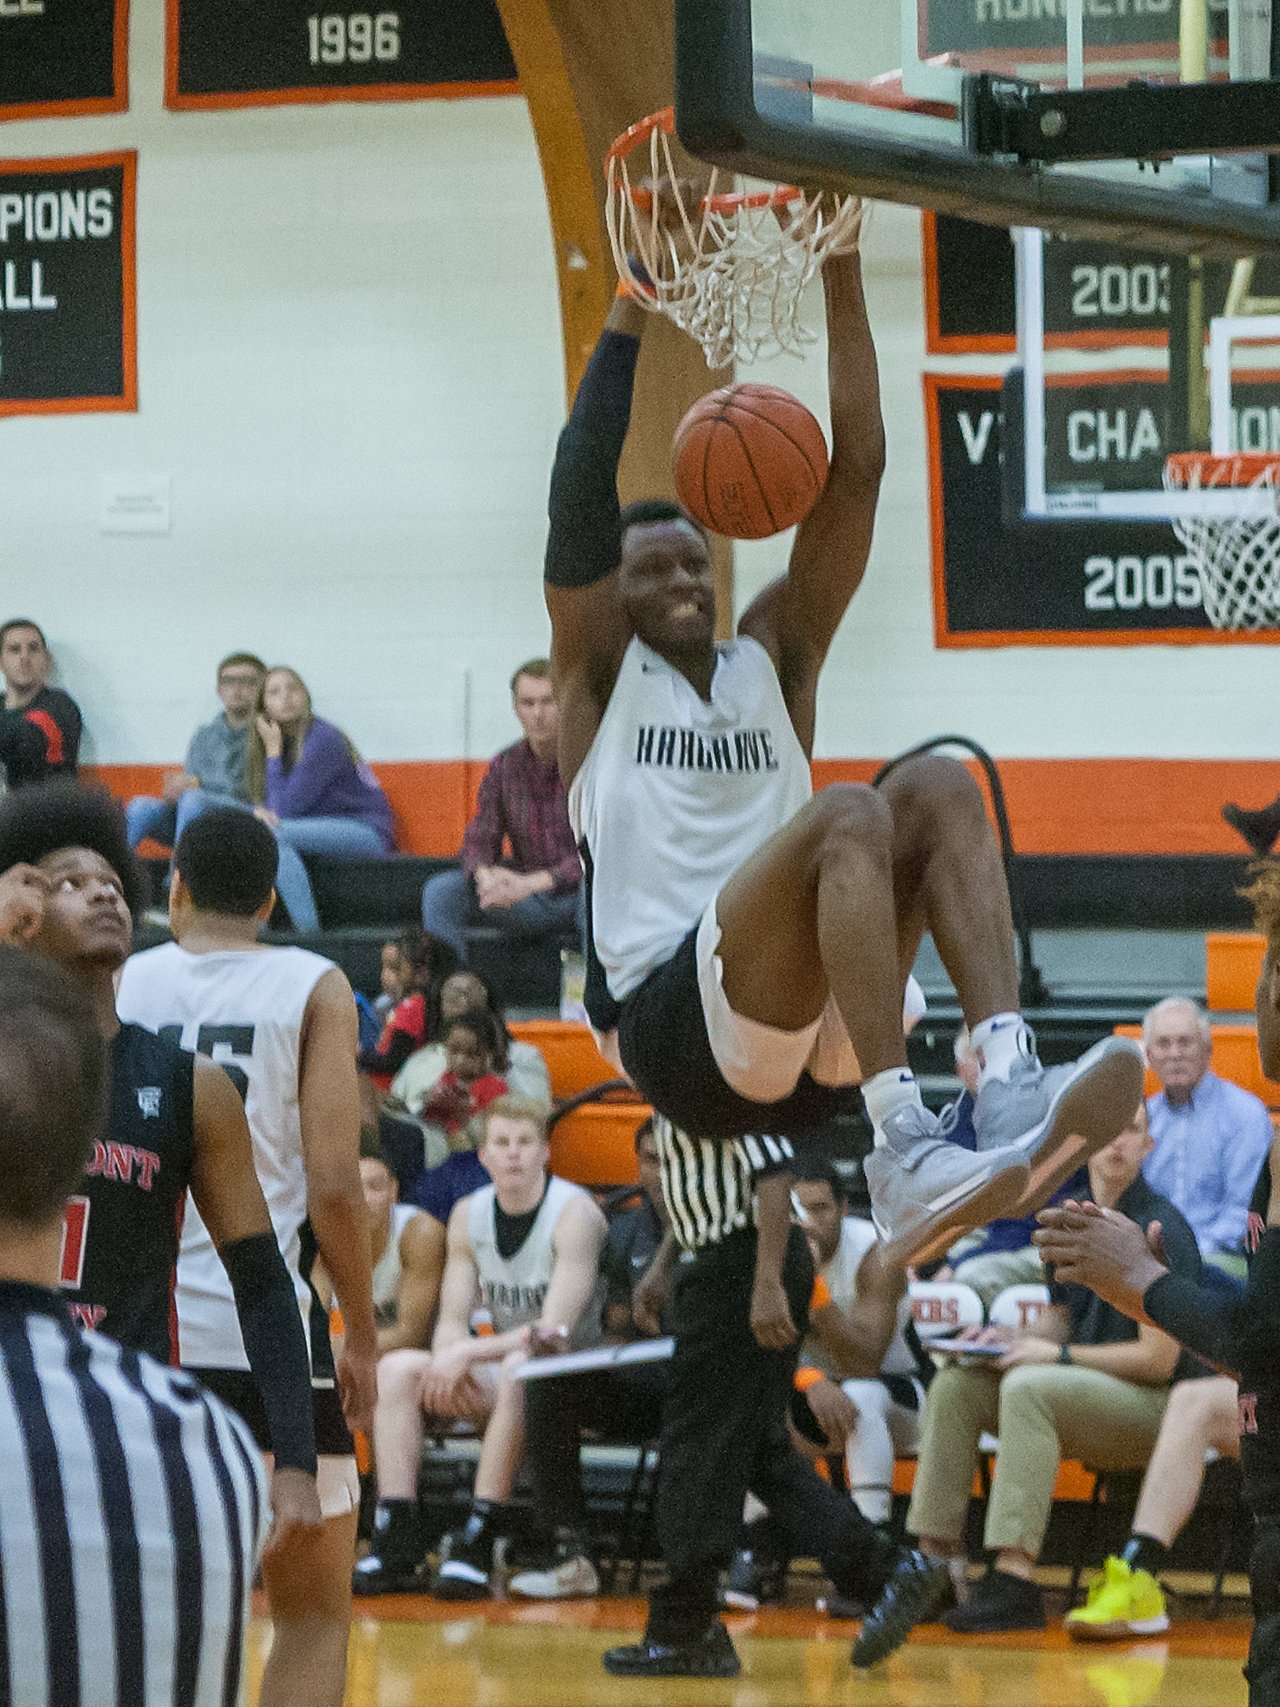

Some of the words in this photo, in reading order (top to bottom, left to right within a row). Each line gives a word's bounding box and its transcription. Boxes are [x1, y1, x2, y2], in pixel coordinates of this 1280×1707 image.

[308, 14, 401, 64] 1996
[0, 259, 58, 311] LL
[1084, 555, 1202, 611] 2005
